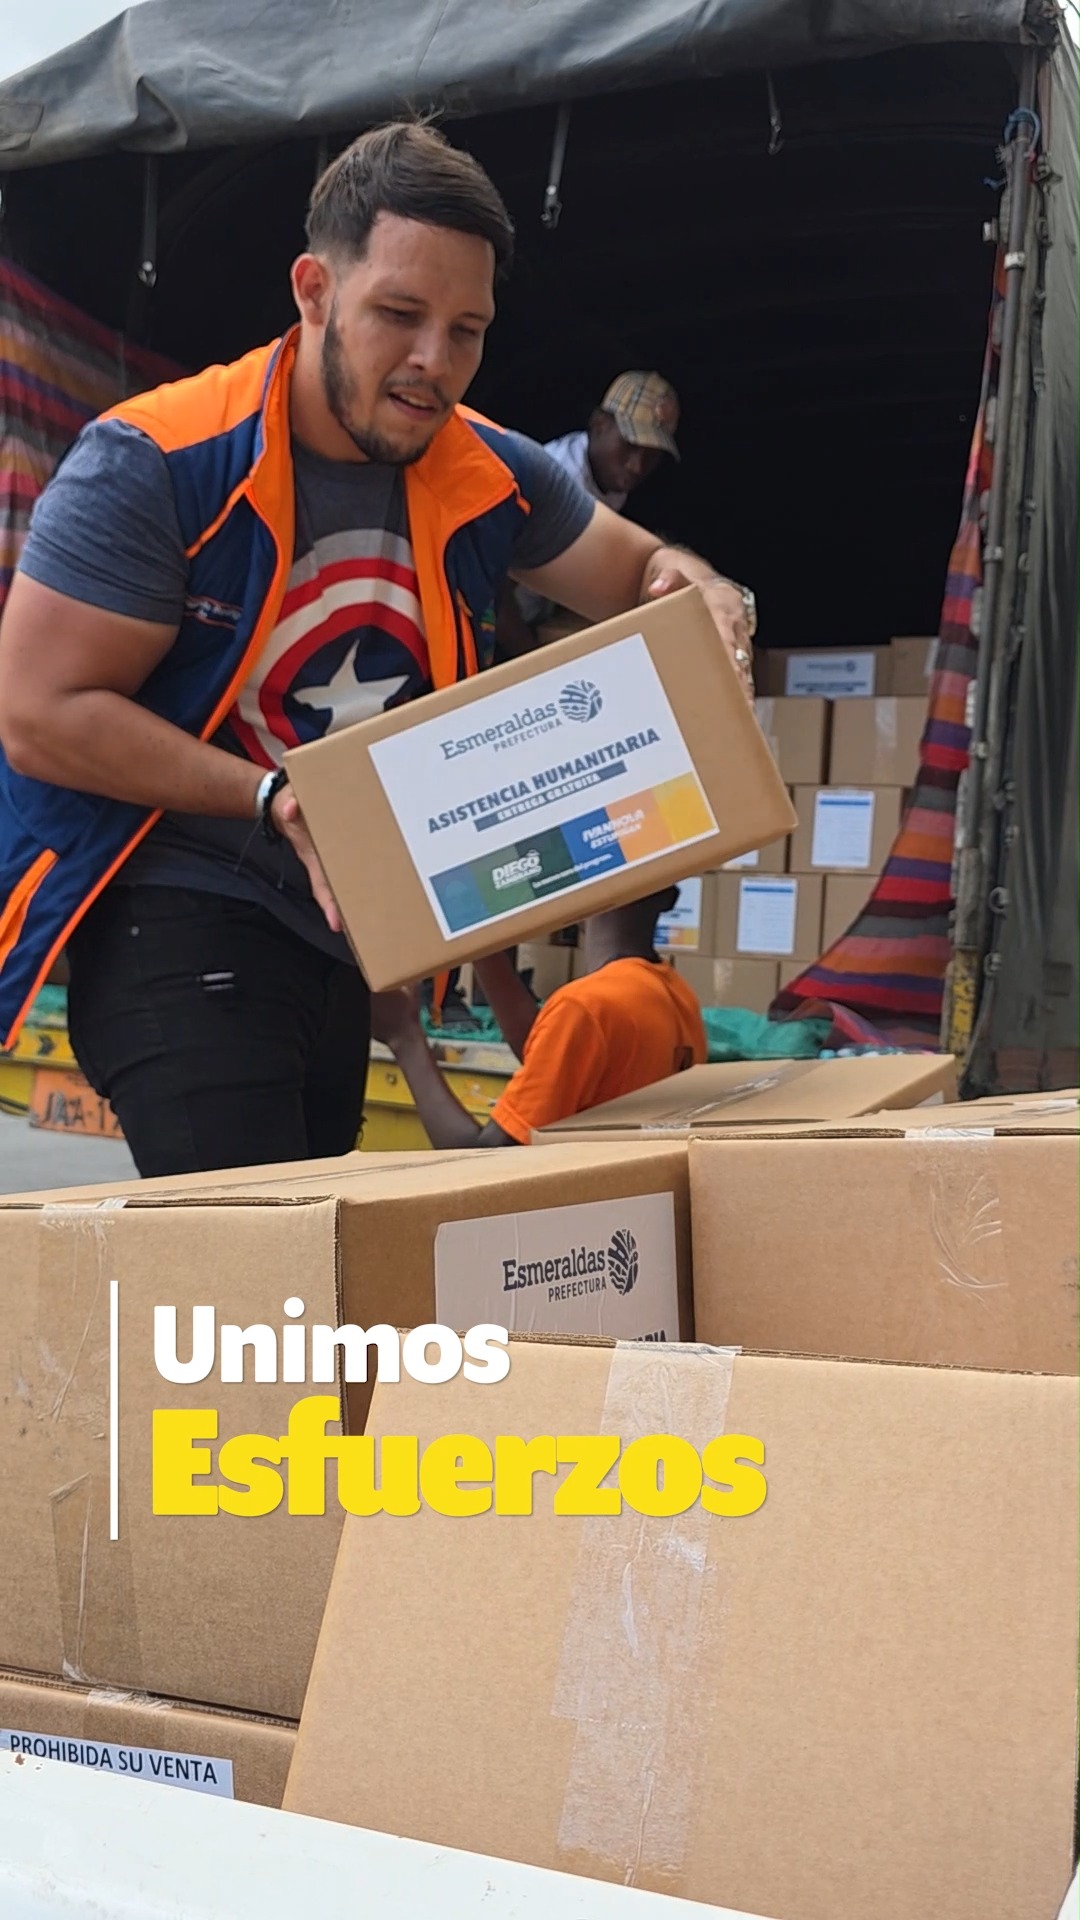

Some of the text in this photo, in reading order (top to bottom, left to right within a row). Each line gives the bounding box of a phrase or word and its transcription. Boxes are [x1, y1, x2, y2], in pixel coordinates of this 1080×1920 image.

[440, 702, 558, 759] Esmeraldas
[493, 719, 563, 752] PREFECTURA
[427, 728, 661, 834] ASISTENCIA HUMANITARIA
[496, 772, 602, 822] ENTREGA GRATUITA
[492, 855, 540, 880] DIEGO
[42, 1091, 121, 1131] JAA-1
[502, 1246, 606, 1292] Esmeraldas
[548, 1276, 607, 1303] PREFECTURA
[10, 1734, 218, 1785] PROHIBIDA SU VENTA
